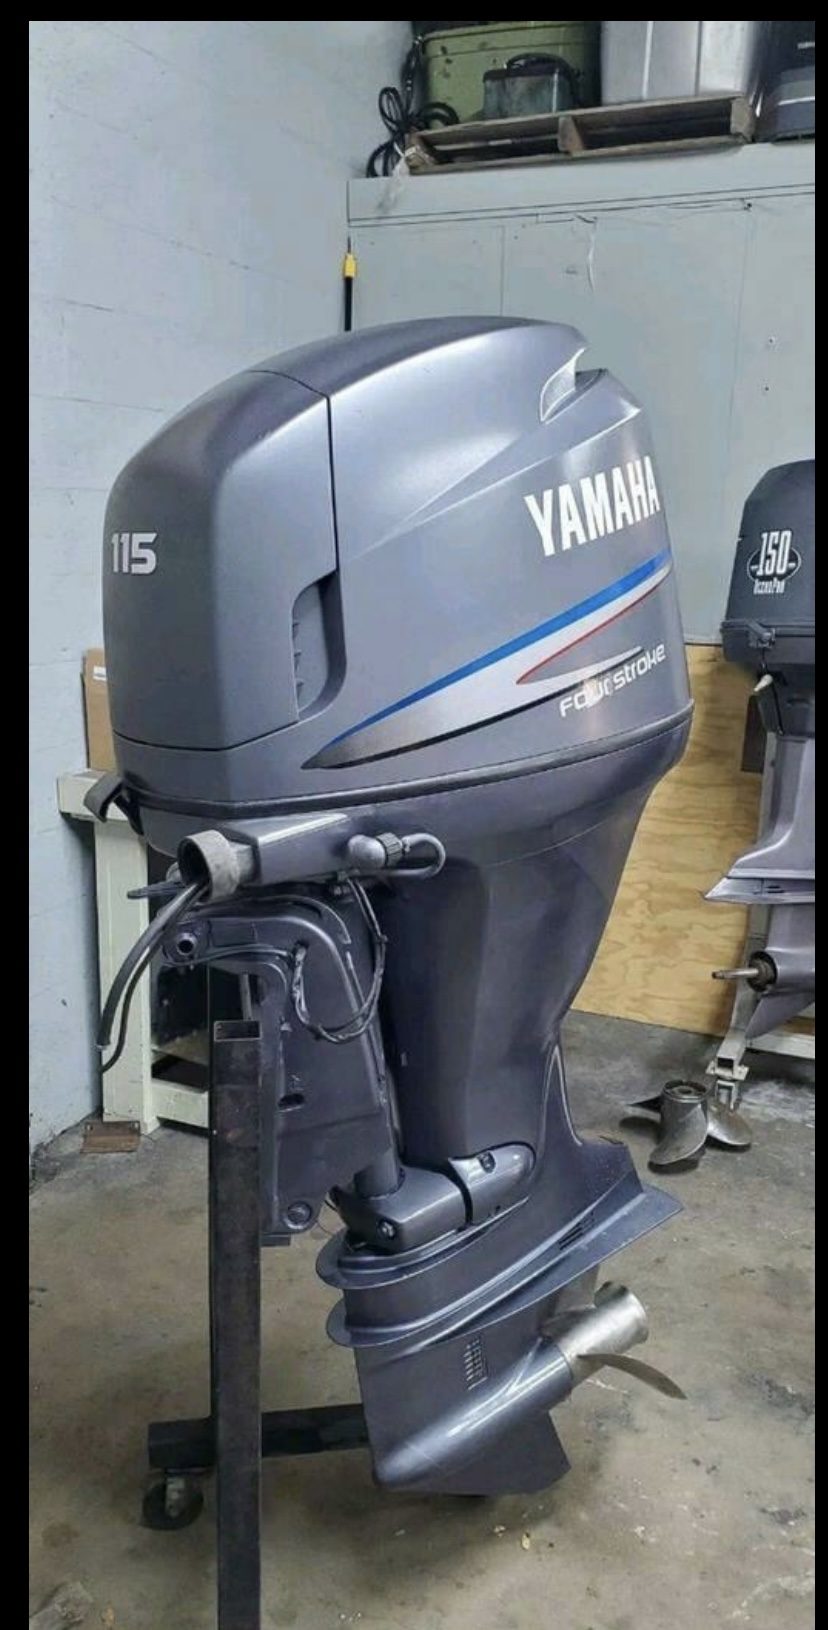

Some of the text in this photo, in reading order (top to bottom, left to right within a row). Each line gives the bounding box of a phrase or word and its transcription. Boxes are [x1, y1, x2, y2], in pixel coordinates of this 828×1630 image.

[523, 455, 660, 557] YAMAHA
[111, 532, 158, 575] 115
[756, 530, 792, 577] 150
